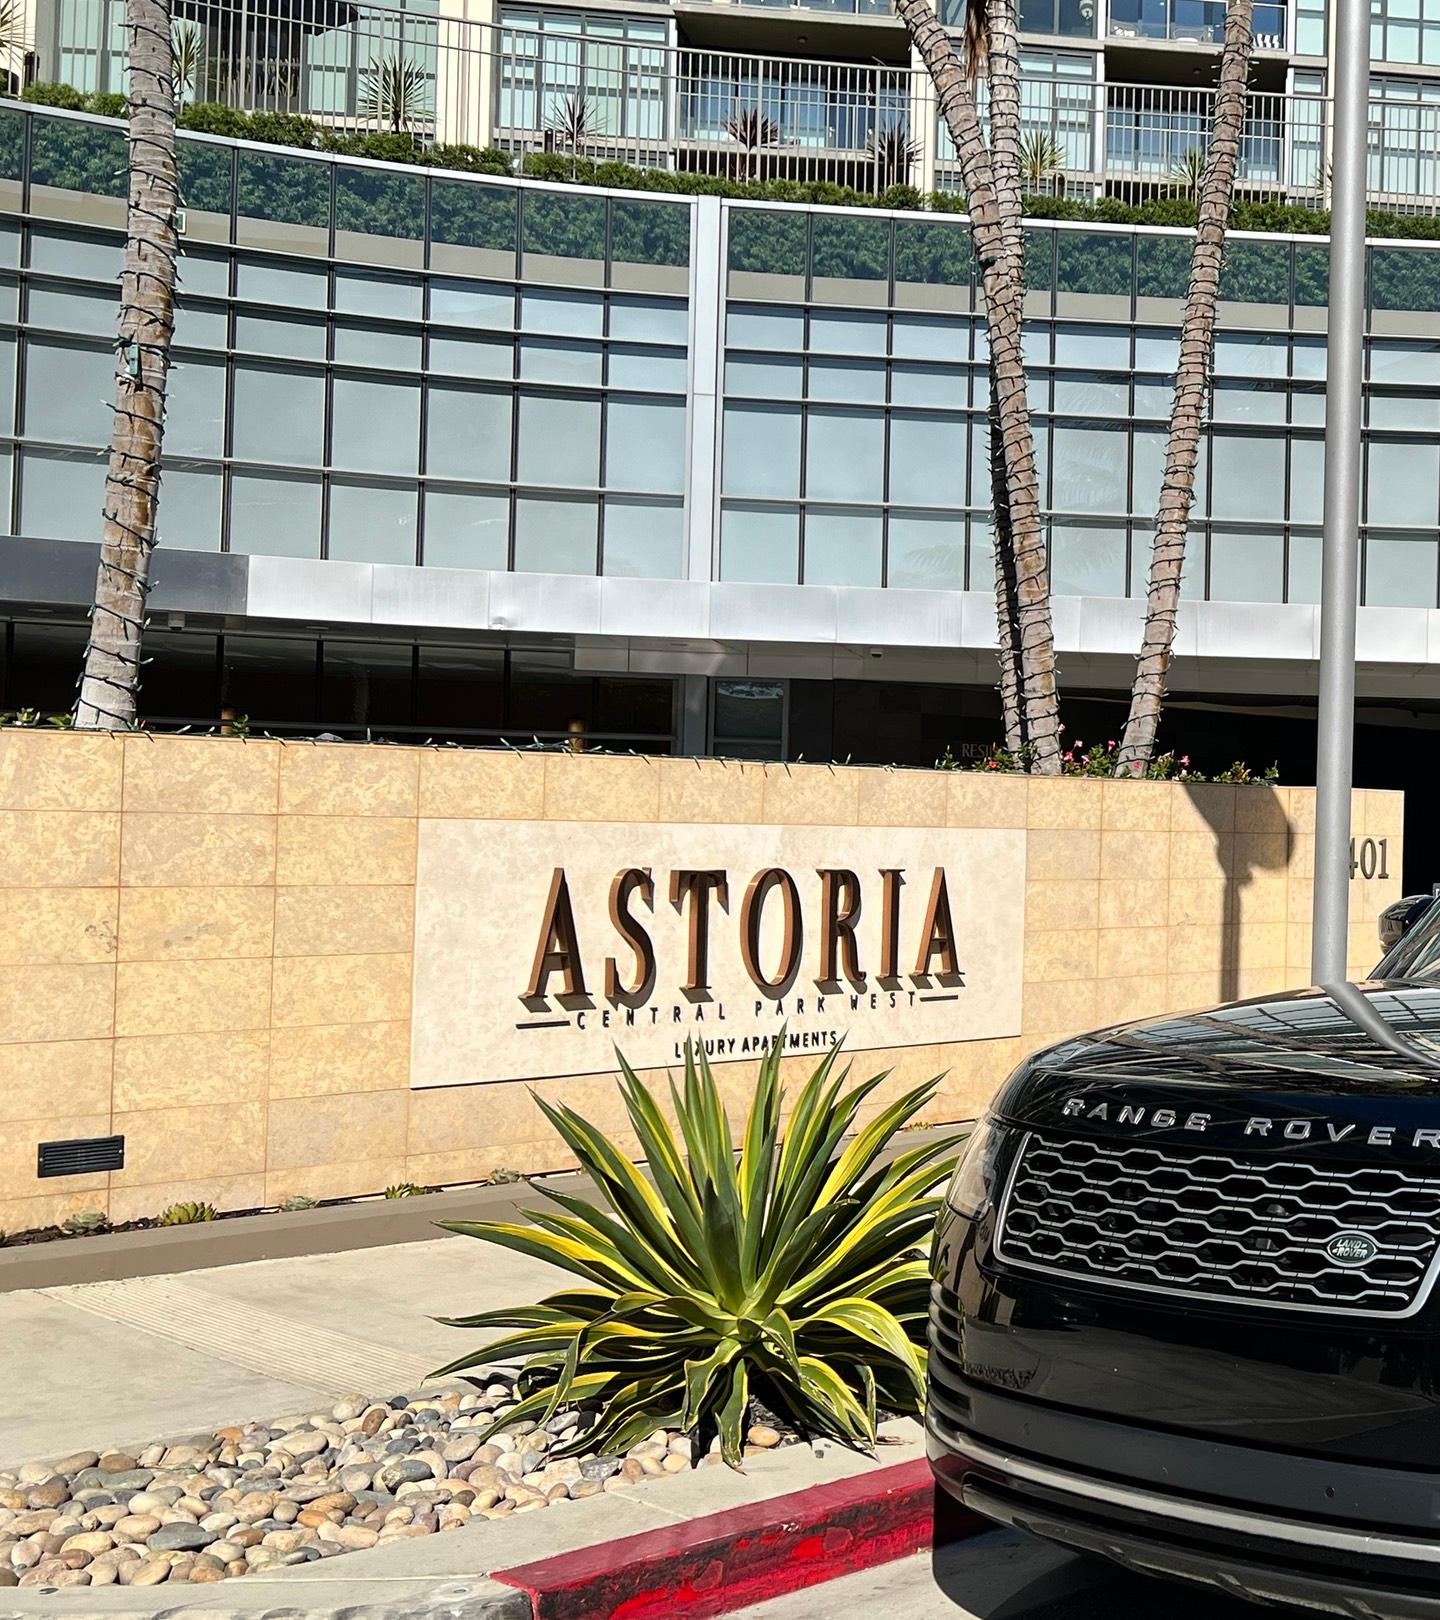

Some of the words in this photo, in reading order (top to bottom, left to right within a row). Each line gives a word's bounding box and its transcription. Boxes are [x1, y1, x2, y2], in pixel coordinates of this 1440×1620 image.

[517, 866, 966, 1002] ASTORIA
[577, 1003, 726, 1030] CENTRAL
[755, 996, 826, 1017] PARK
[850, 991, 916, 1011] WEST
[1061, 1097, 1212, 1133] RANGE
[1336, 1239, 1362, 1248] LAND
[1336, 1247, 1368, 1258] ROVER
